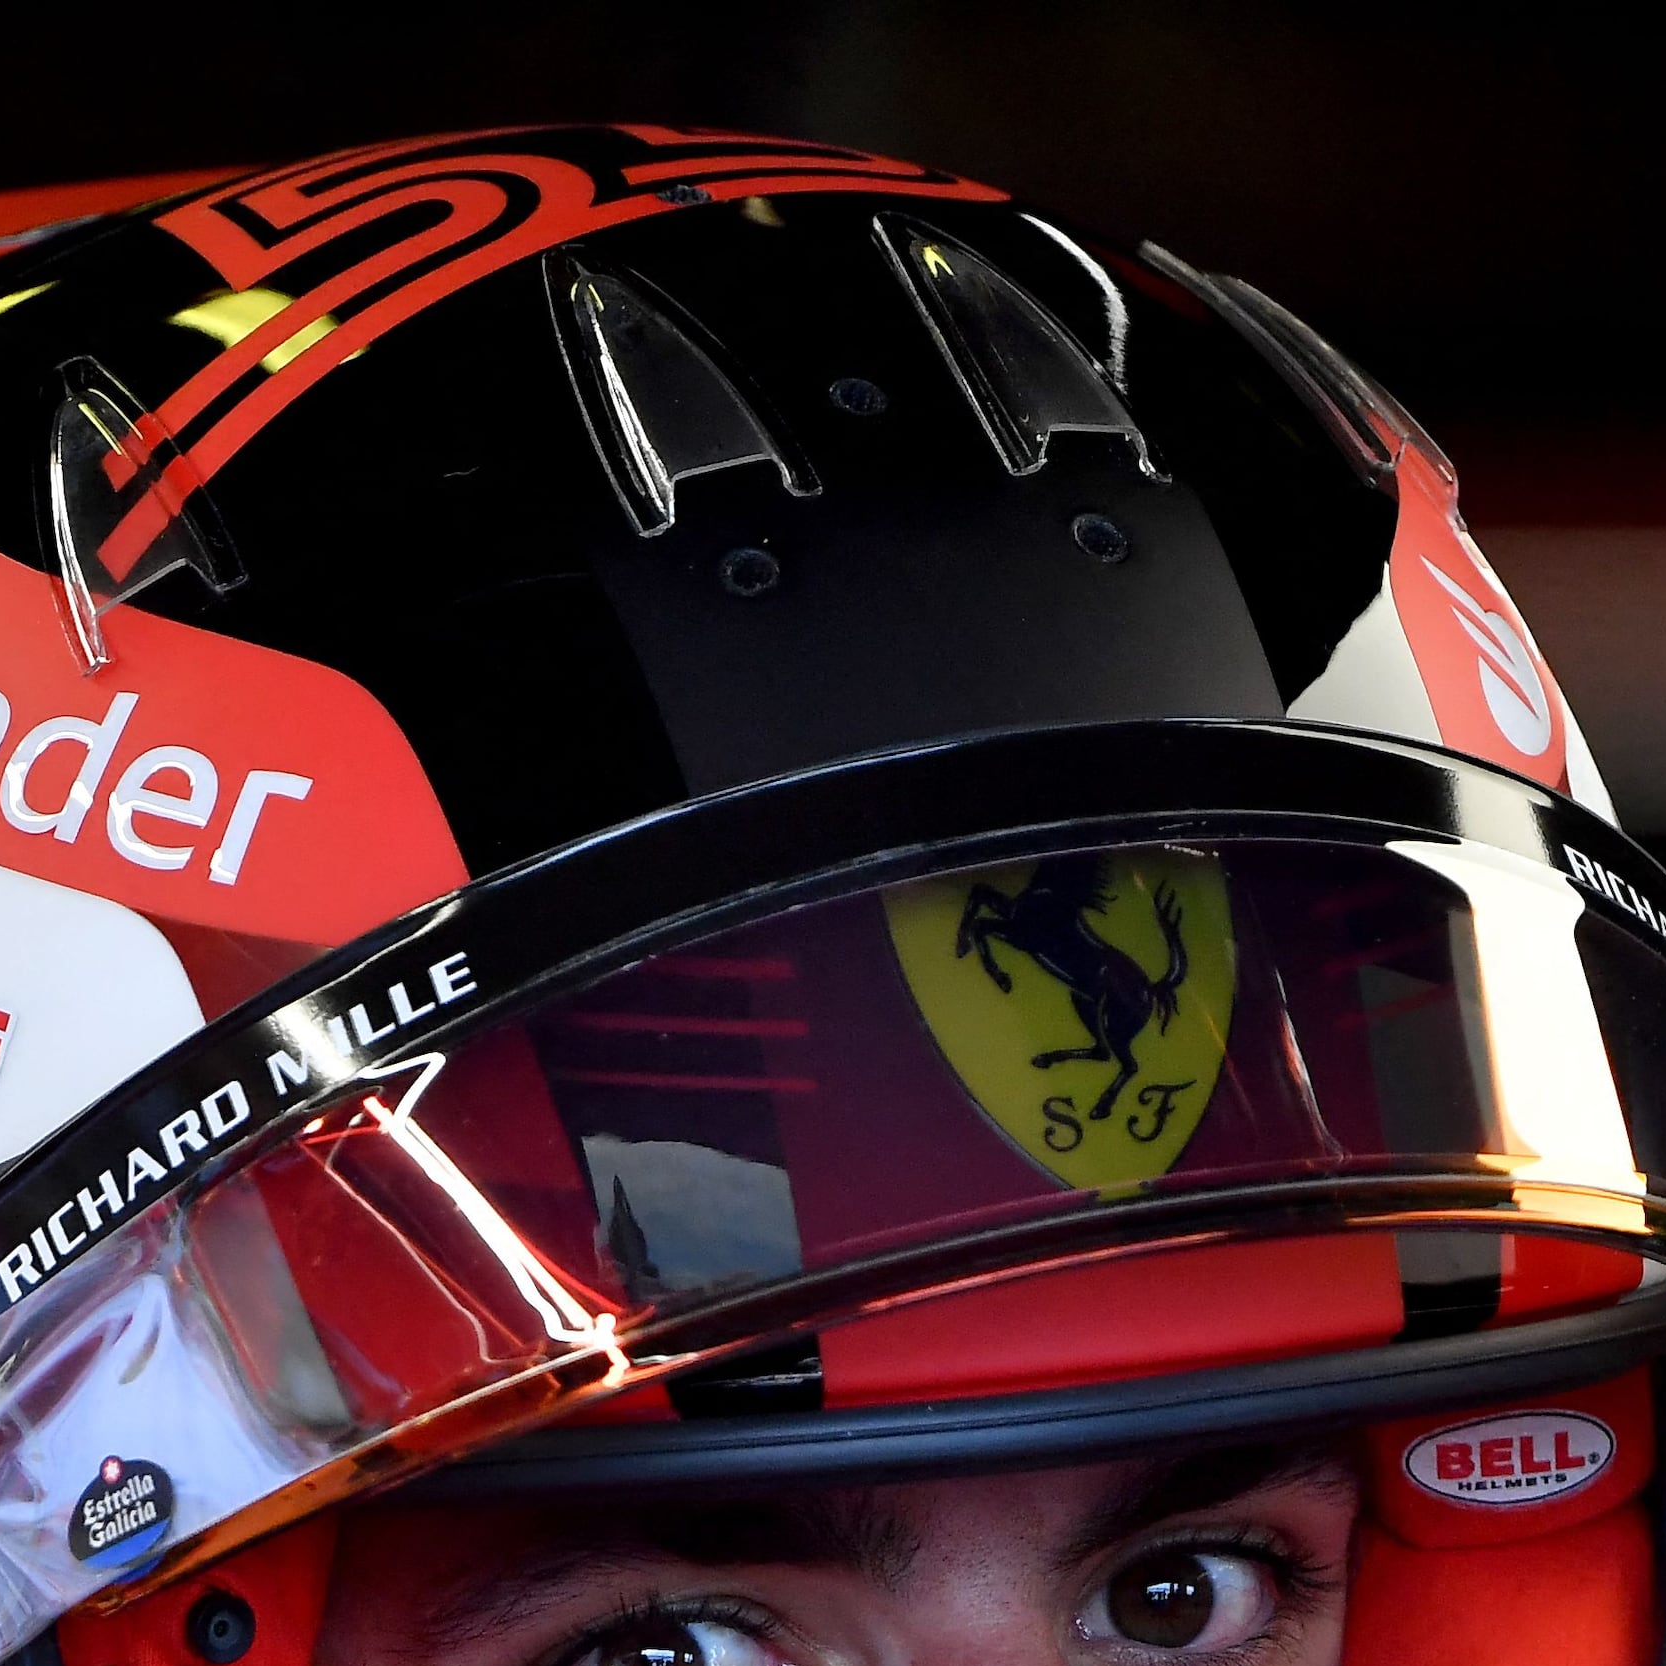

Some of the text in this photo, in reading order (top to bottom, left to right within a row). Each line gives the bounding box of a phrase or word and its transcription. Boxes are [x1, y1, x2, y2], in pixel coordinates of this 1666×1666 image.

[266, 951, 478, 1096] MILLE
[1042, 1096, 1083, 1152] S
[1436, 1431, 1586, 1480] BELL
[84, 1474, 155, 1525] Estrella
[1458, 1473, 1568, 1491] HELMETS
[89, 1501, 157, 1548] Galicia
